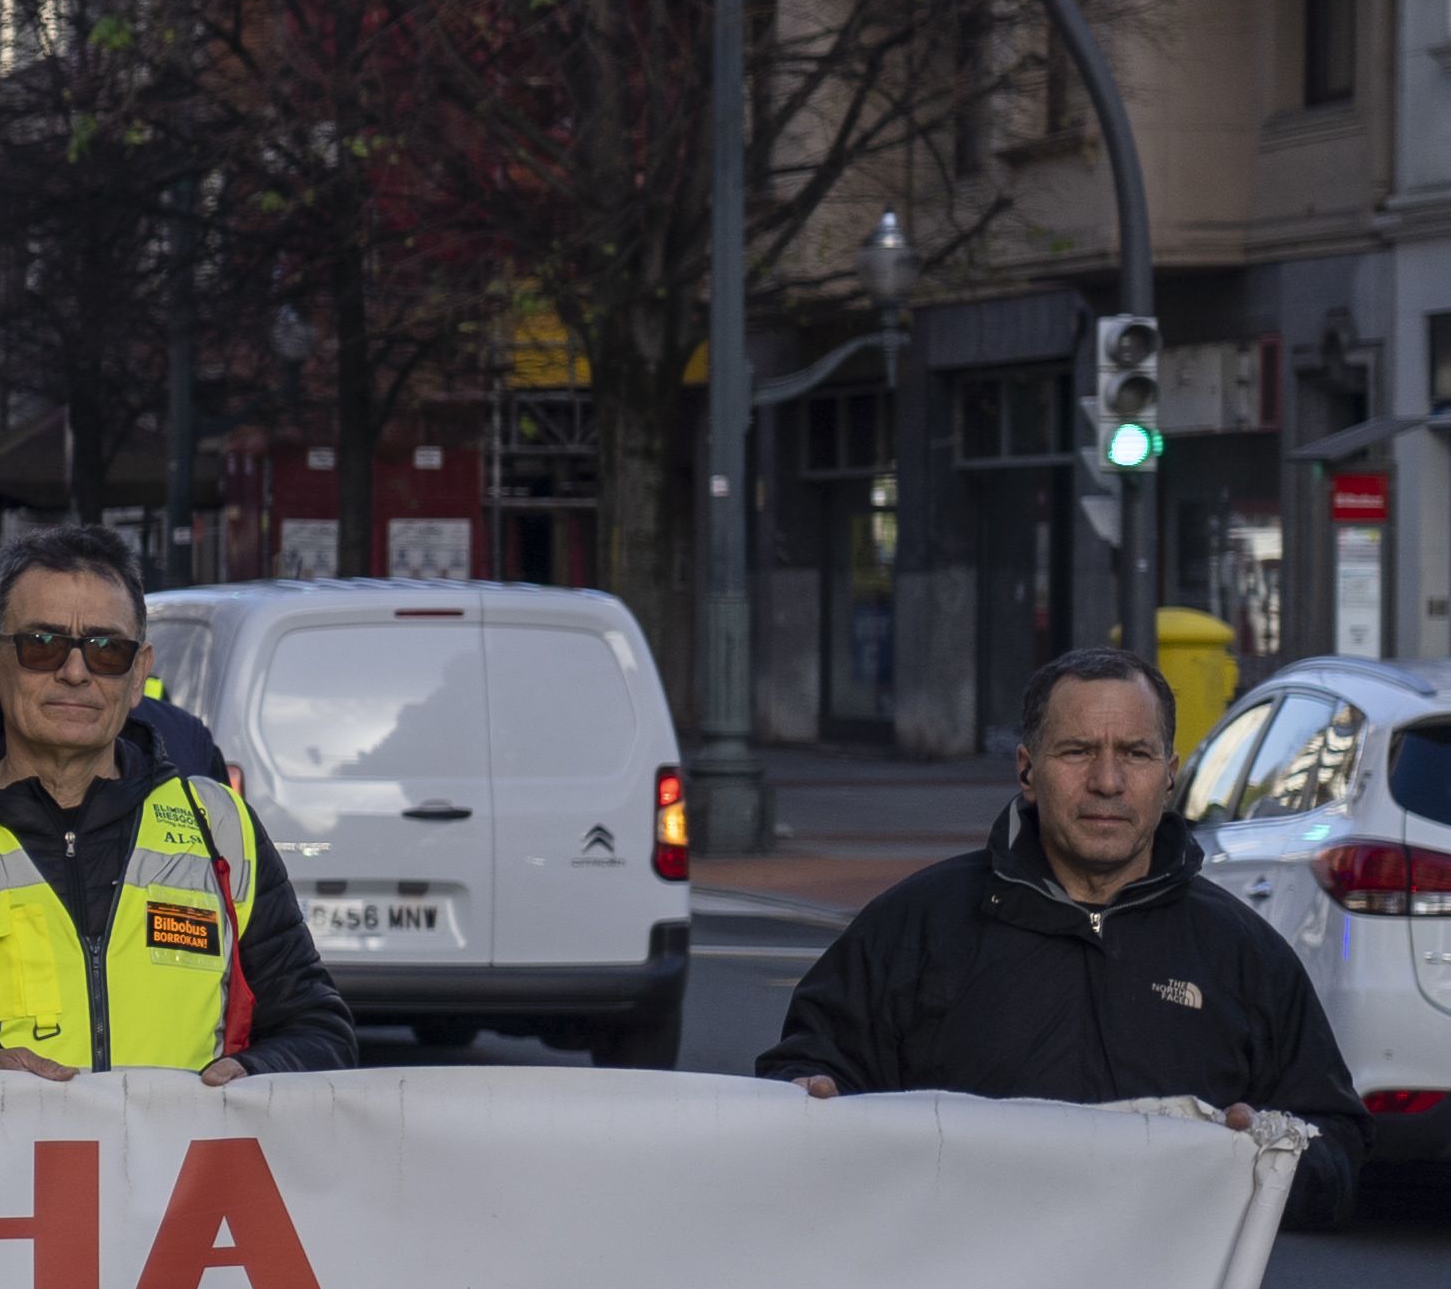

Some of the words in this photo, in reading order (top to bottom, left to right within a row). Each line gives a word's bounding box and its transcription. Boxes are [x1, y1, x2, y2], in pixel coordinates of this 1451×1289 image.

[155, 811, 197, 827] RIESGO
[154, 915, 207, 937] Bilbobus
[388, 905, 437, 930] MNW
[153, 931, 208, 949] BORROKAN!
[1152, 982, 1186, 997] NORTH
[1168, 978, 1186, 989] THE
